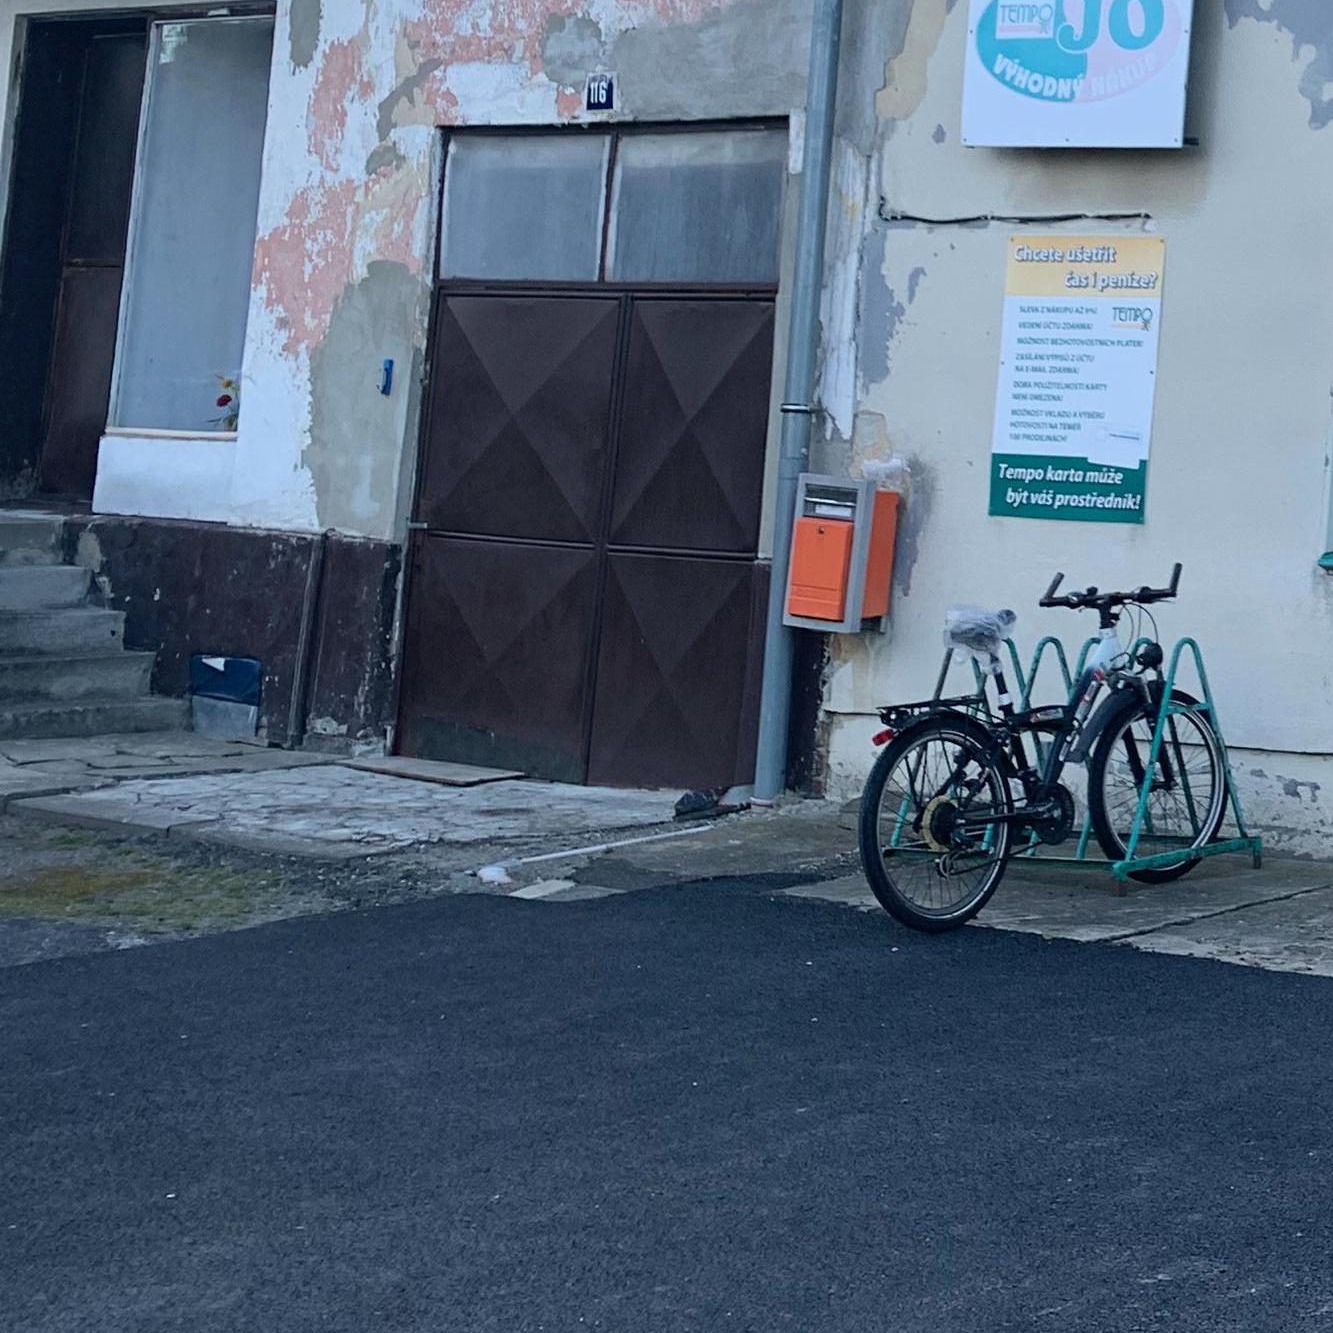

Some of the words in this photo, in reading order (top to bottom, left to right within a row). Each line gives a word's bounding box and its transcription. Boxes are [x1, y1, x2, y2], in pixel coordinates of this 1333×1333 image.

[999, 4, 1053, 24] TEMPO
[992, 53, 1085, 100] VÝHODNÝ
[590, 81, 608, 104] 116
[1015, 244, 1063, 263] Chcete
[1066, 245, 1117, 263] ušetřit
[1065, 271, 1089, 288] čas
[1099, 272, 1158, 292] peníze?
[1112, 307, 1153, 323] TEMPO
[998, 463, 1044, 483] Tempo
[1046, 465, 1085, 483] karta
[1085, 467, 1124, 484] může
[1006, 487, 1028, 507] být
[1030, 488, 1054, 506] váš
[1053, 491, 1142, 510] prostředník!
